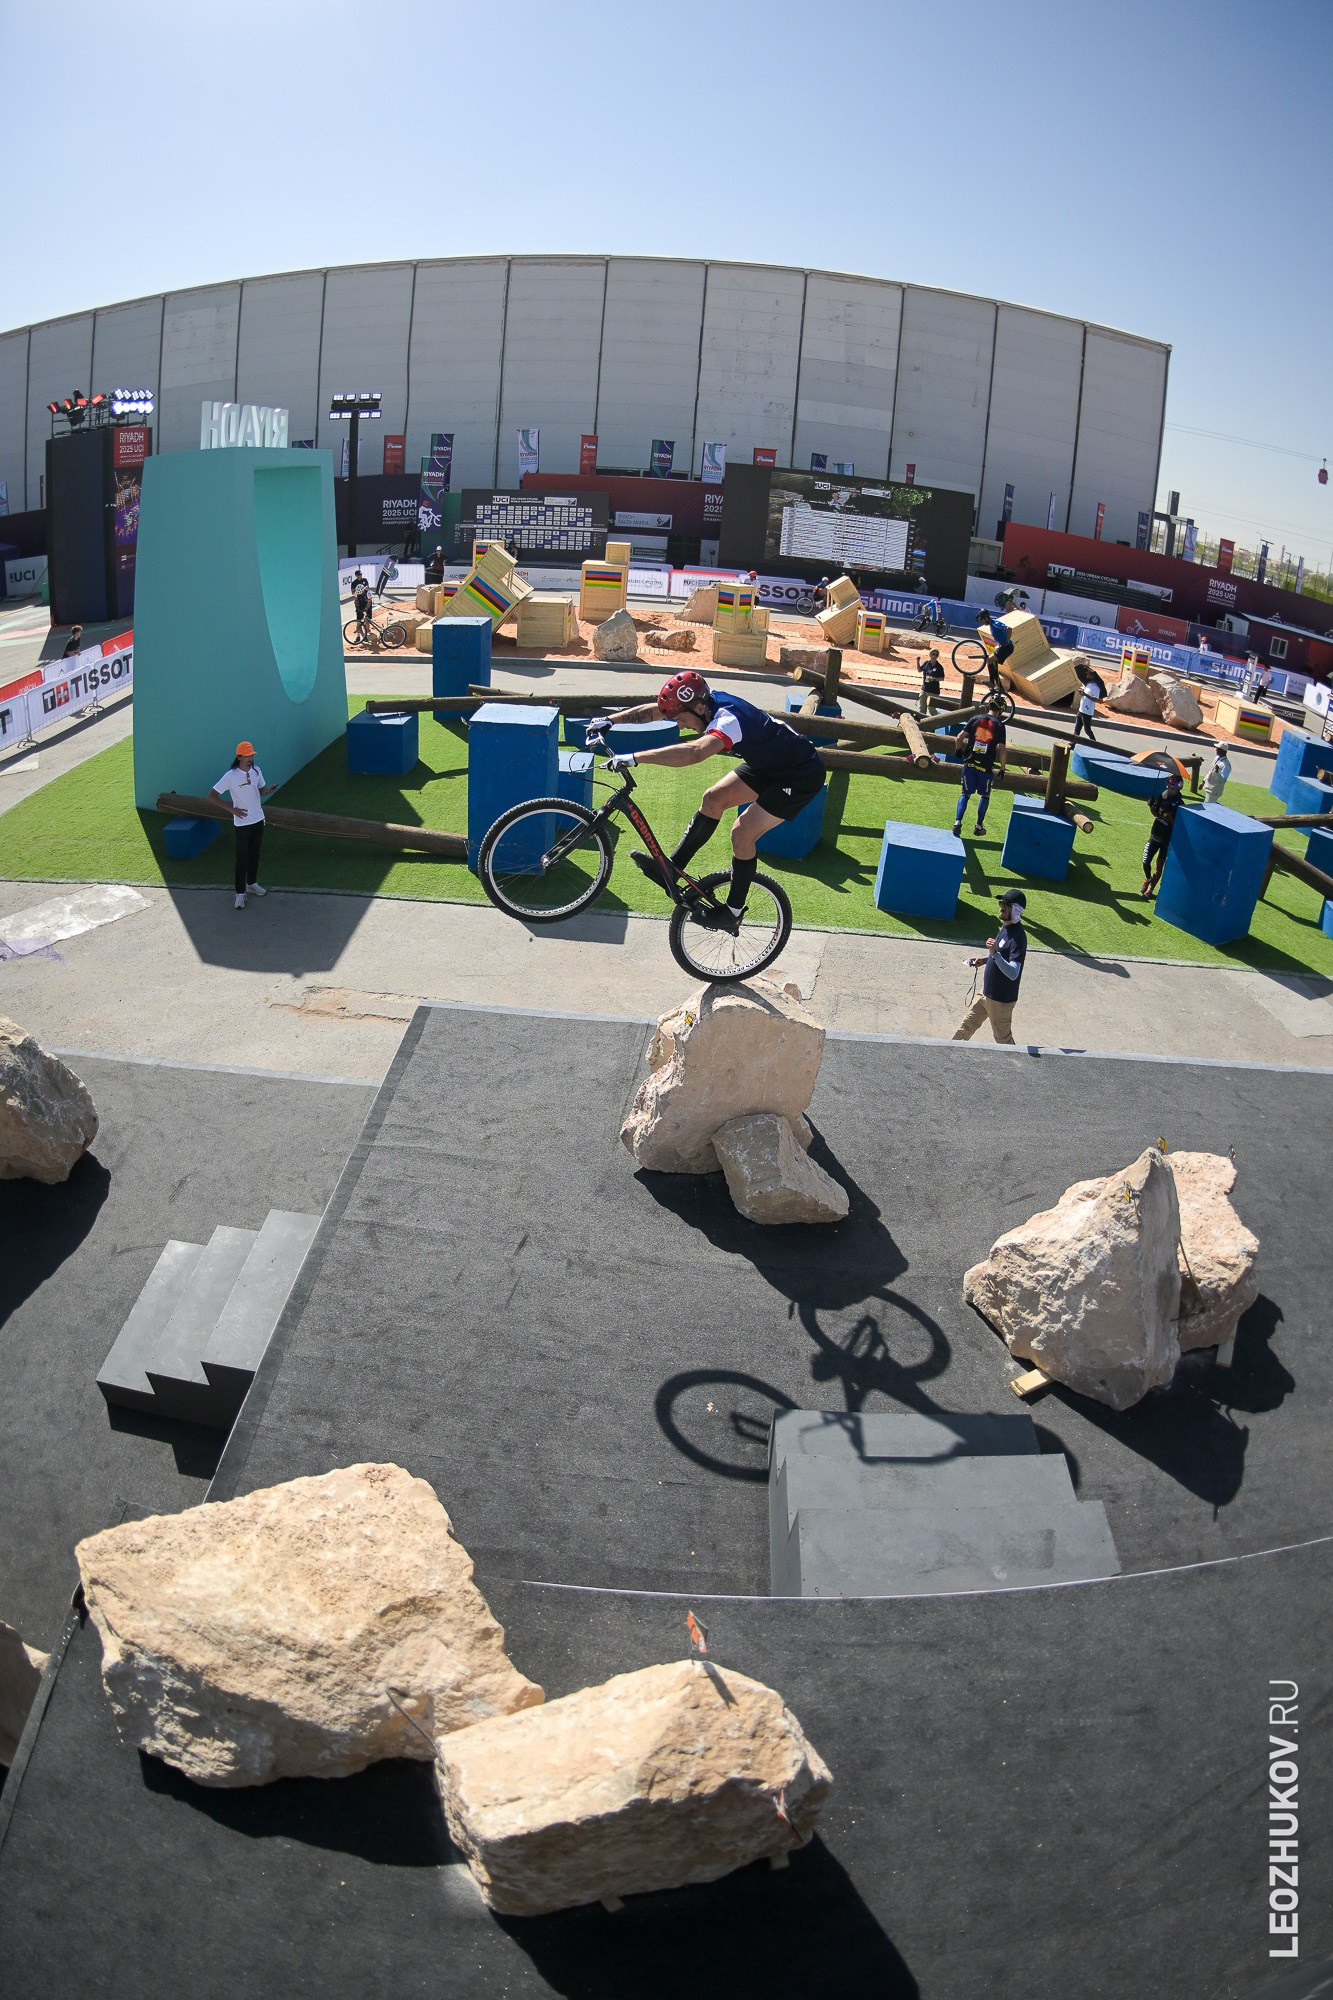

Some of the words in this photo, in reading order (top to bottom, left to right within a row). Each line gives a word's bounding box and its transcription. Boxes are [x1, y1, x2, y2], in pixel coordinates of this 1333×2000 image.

[119, 432, 144, 443] RIYADH
[119, 445, 133, 453] 2025
[383, 499, 417, 508] RIYADH
[14, 570, 35, 582] UCI
[1100, 574, 1119, 583] CYCLING
[1208, 578, 1237, 593] RIYADH
[1207, 587, 1223, 598] 2025
[1224, 591, 1236, 601] UCI
[1157, 628, 1177, 637] RIYADH
[70, 652, 133, 698] TISSOT
